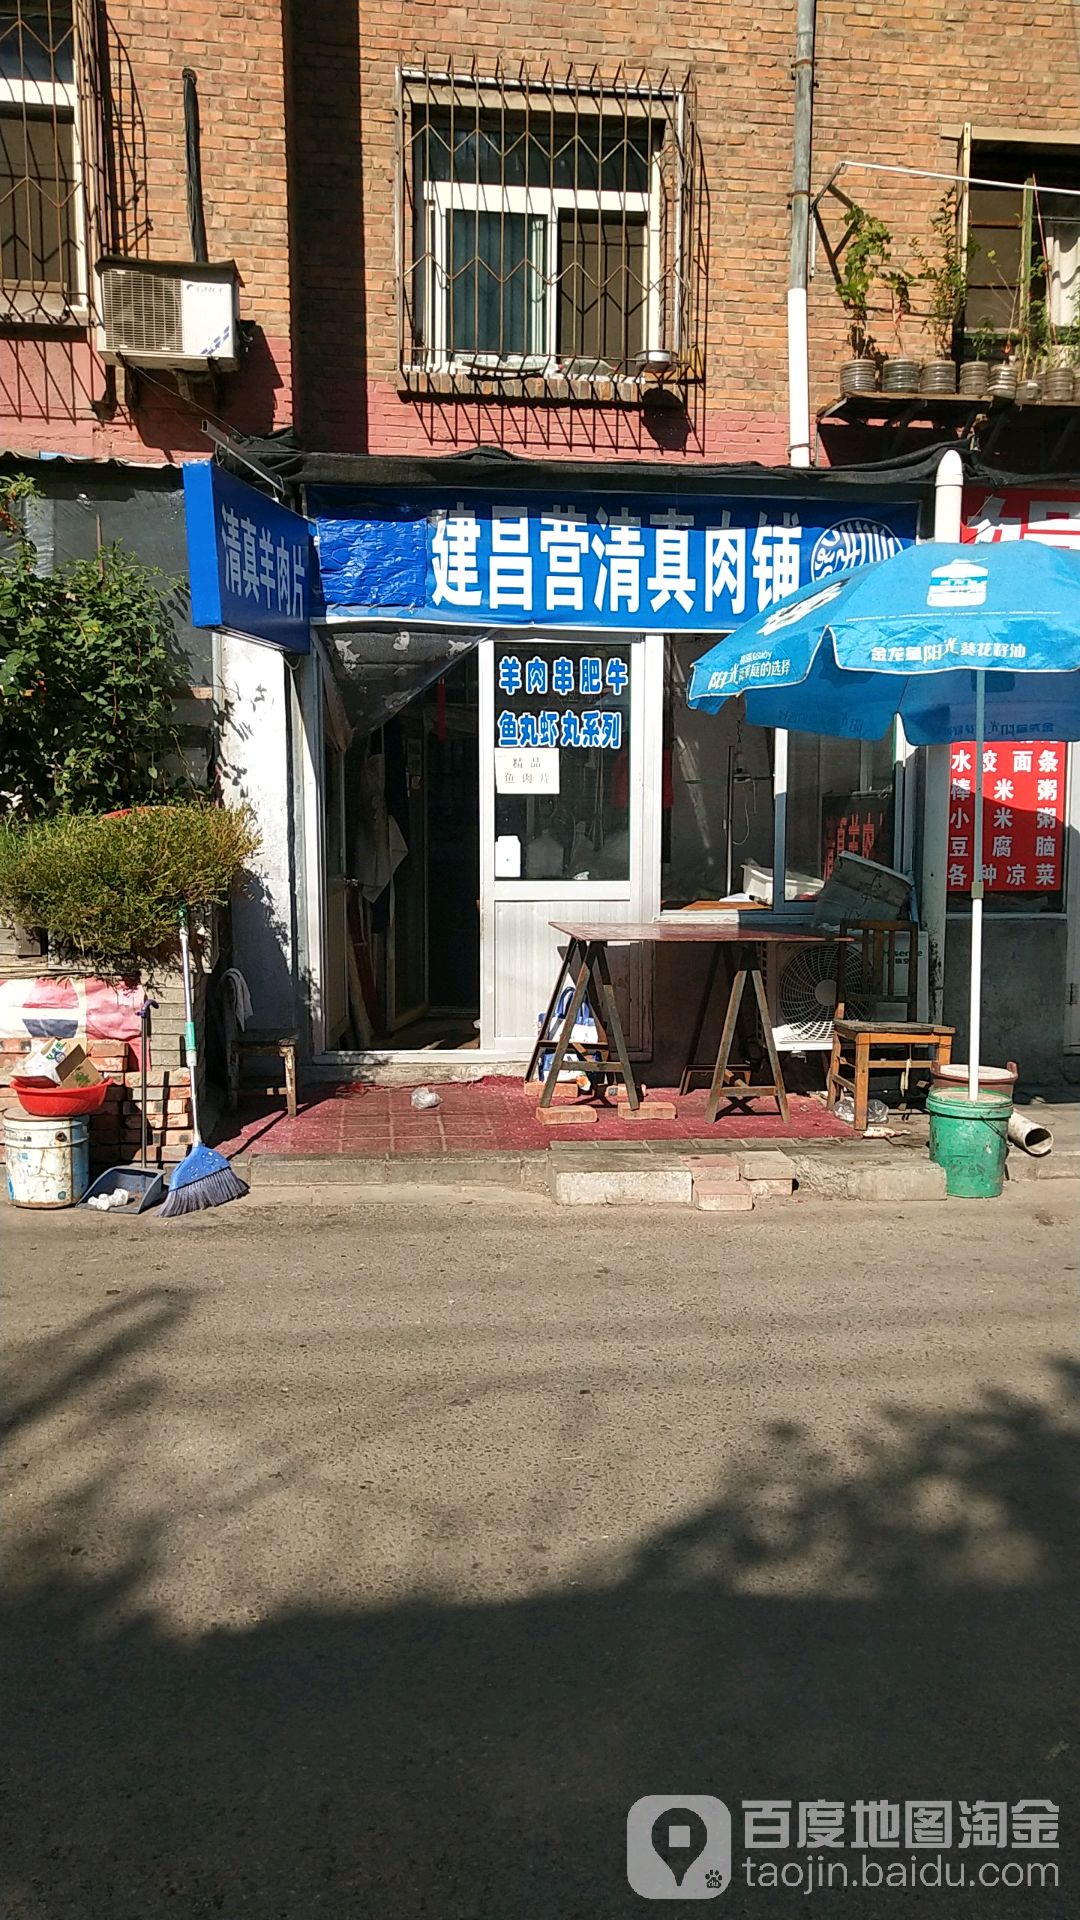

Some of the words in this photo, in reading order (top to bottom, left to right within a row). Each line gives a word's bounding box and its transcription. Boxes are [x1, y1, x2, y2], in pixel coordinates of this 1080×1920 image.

[221, 503, 306, 622] 清真羊肉片
[431, 502, 802, 616] 建昌营清真肉铺
[499, 655, 629, 696] 羊肉串肥牛
[498, 710, 623, 749] 鱼丸虾丸系列
[950, 807, 1057, 830] 小米粥
[950, 835, 1056, 858] 豆腐脑
